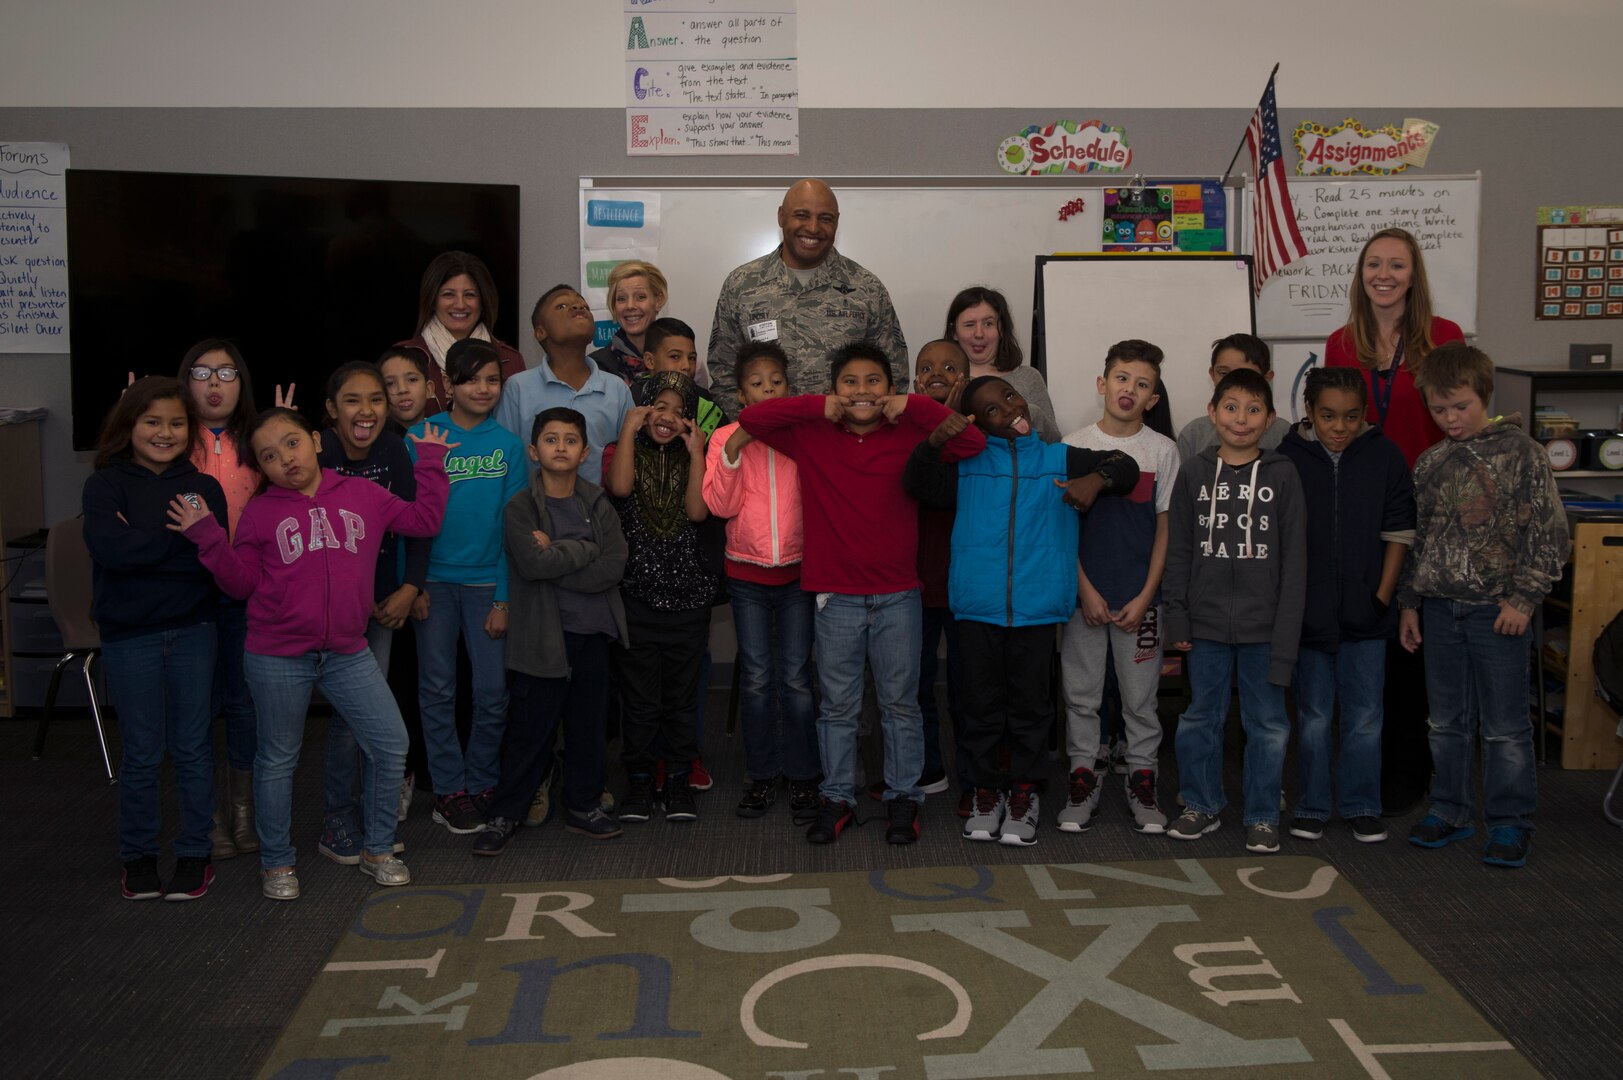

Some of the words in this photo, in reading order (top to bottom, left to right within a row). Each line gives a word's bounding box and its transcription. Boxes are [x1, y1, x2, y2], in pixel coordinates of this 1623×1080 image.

[690, 19, 723, 30] answer
[728, 18, 740, 28] all
[744, 17, 766, 31] parts
[770, 16, 783, 27] of
[694, 35, 711, 45] the
[722, 33, 762, 48] question
[678, 63, 697, 77] give
[701, 62, 736, 74] examples
[740, 62, 754, 70] and
[757, 62, 792, 71] evidence
[680, 78, 701, 88] from
[706, 76, 724, 86] the
[727, 74, 748, 85] text
[705, 89, 723, 102] text
[683, 111, 709, 124] explain
[716, 111, 731, 119] how
[736, 111, 752, 121] your
[756, 111, 793, 121] evidence
[684, 122, 715, 134] supports
[720, 122, 735, 133] your
[0, 144, 49, 166] Forums
[1029, 135, 1126, 164] Schedule
[1306, 129, 1426, 166] Assignments
[1315, 187, 1343, 203] Read
[1349, 187, 1371, 200] 25
[1378, 185, 1425, 199] minutes
[1433, 189, 1451, 199] on
[0, 211, 35, 226] ctively
[593, 205, 640, 222] RESILIENCE
[1314, 206, 1360, 220] Complete
[1365, 209, 1384, 217] one
[1390, 206, 1419, 220] story
[1422, 204, 1444, 214] and
[0, 222, 32, 240] tening
[37, 222, 50, 233] to
[1298, 222, 1366, 236] omprehension
[1425, 215, 1457, 227] Write
[0, 235, 39, 246] esenter
[1307, 234, 1329, 243] read
[1332, 235, 1345, 243] on
[1415, 229, 1465, 244] Complete
[1552, 252, 1559, 260] 5
[1593, 250, 1601, 260] 7
[0, 286, 14, 297] ait
[19, 286, 36, 298] and
[41, 286, 67, 298] listen
[1288, 283, 1349, 300] FRIDAY
[19, 299, 66, 312] presenter
[16, 310, 59, 320] finished
[36, 322, 63, 335] Cheer
[1216, 513, 1269, 531] POS
[275, 507, 366, 565] GAP
[1200, 541, 1269, 560] TALE
